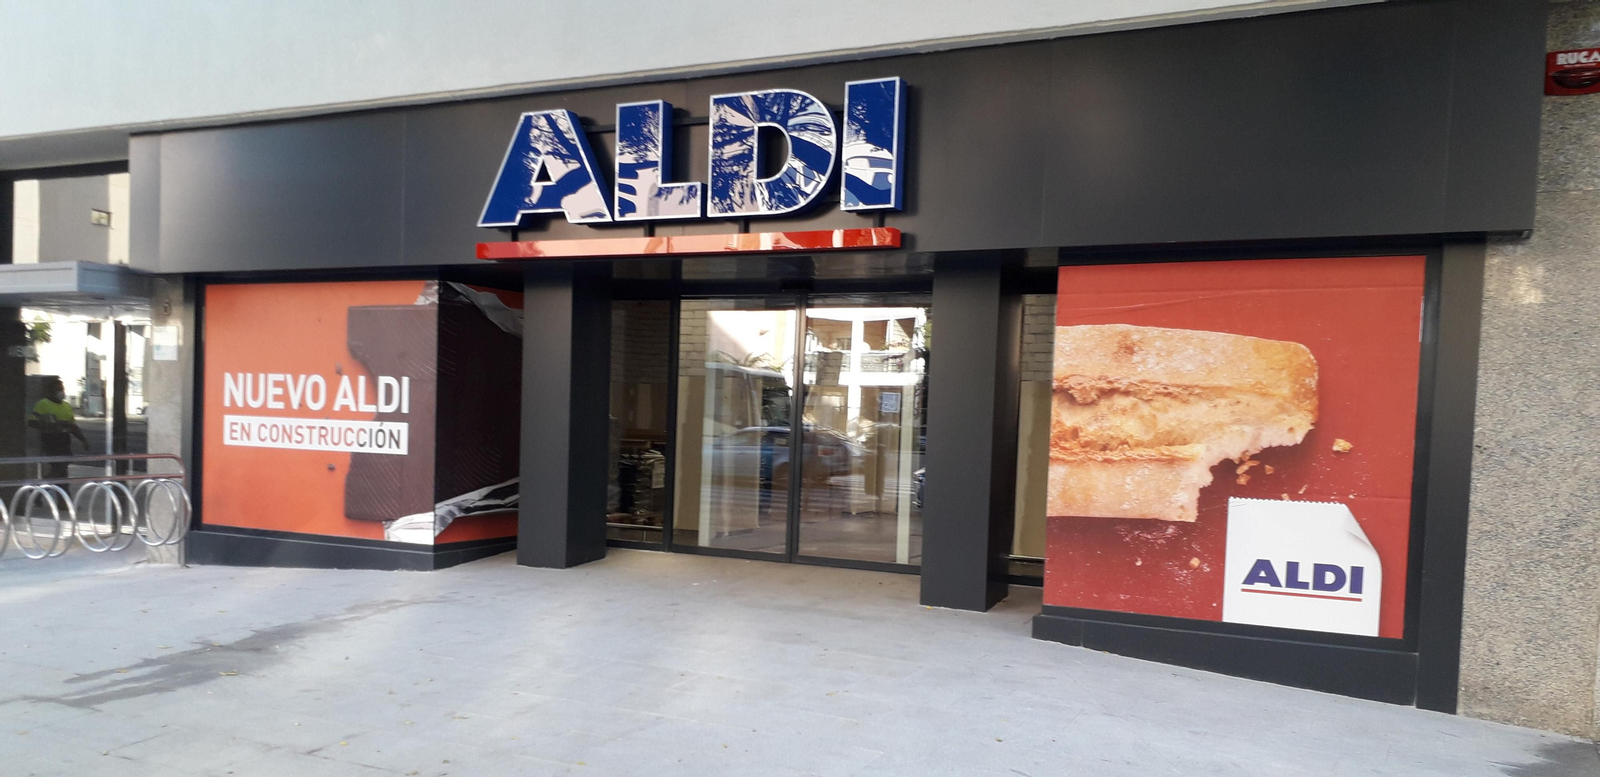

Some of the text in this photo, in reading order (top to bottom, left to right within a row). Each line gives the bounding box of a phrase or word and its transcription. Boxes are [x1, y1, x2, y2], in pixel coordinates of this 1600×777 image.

[477, 76, 907, 229] ALDI
[223, 372, 410, 414] NUEVO ALDI
[229, 421, 401, 449] EN CONSTRUCCIÓN
[1241, 558, 1364, 594] ALDI
